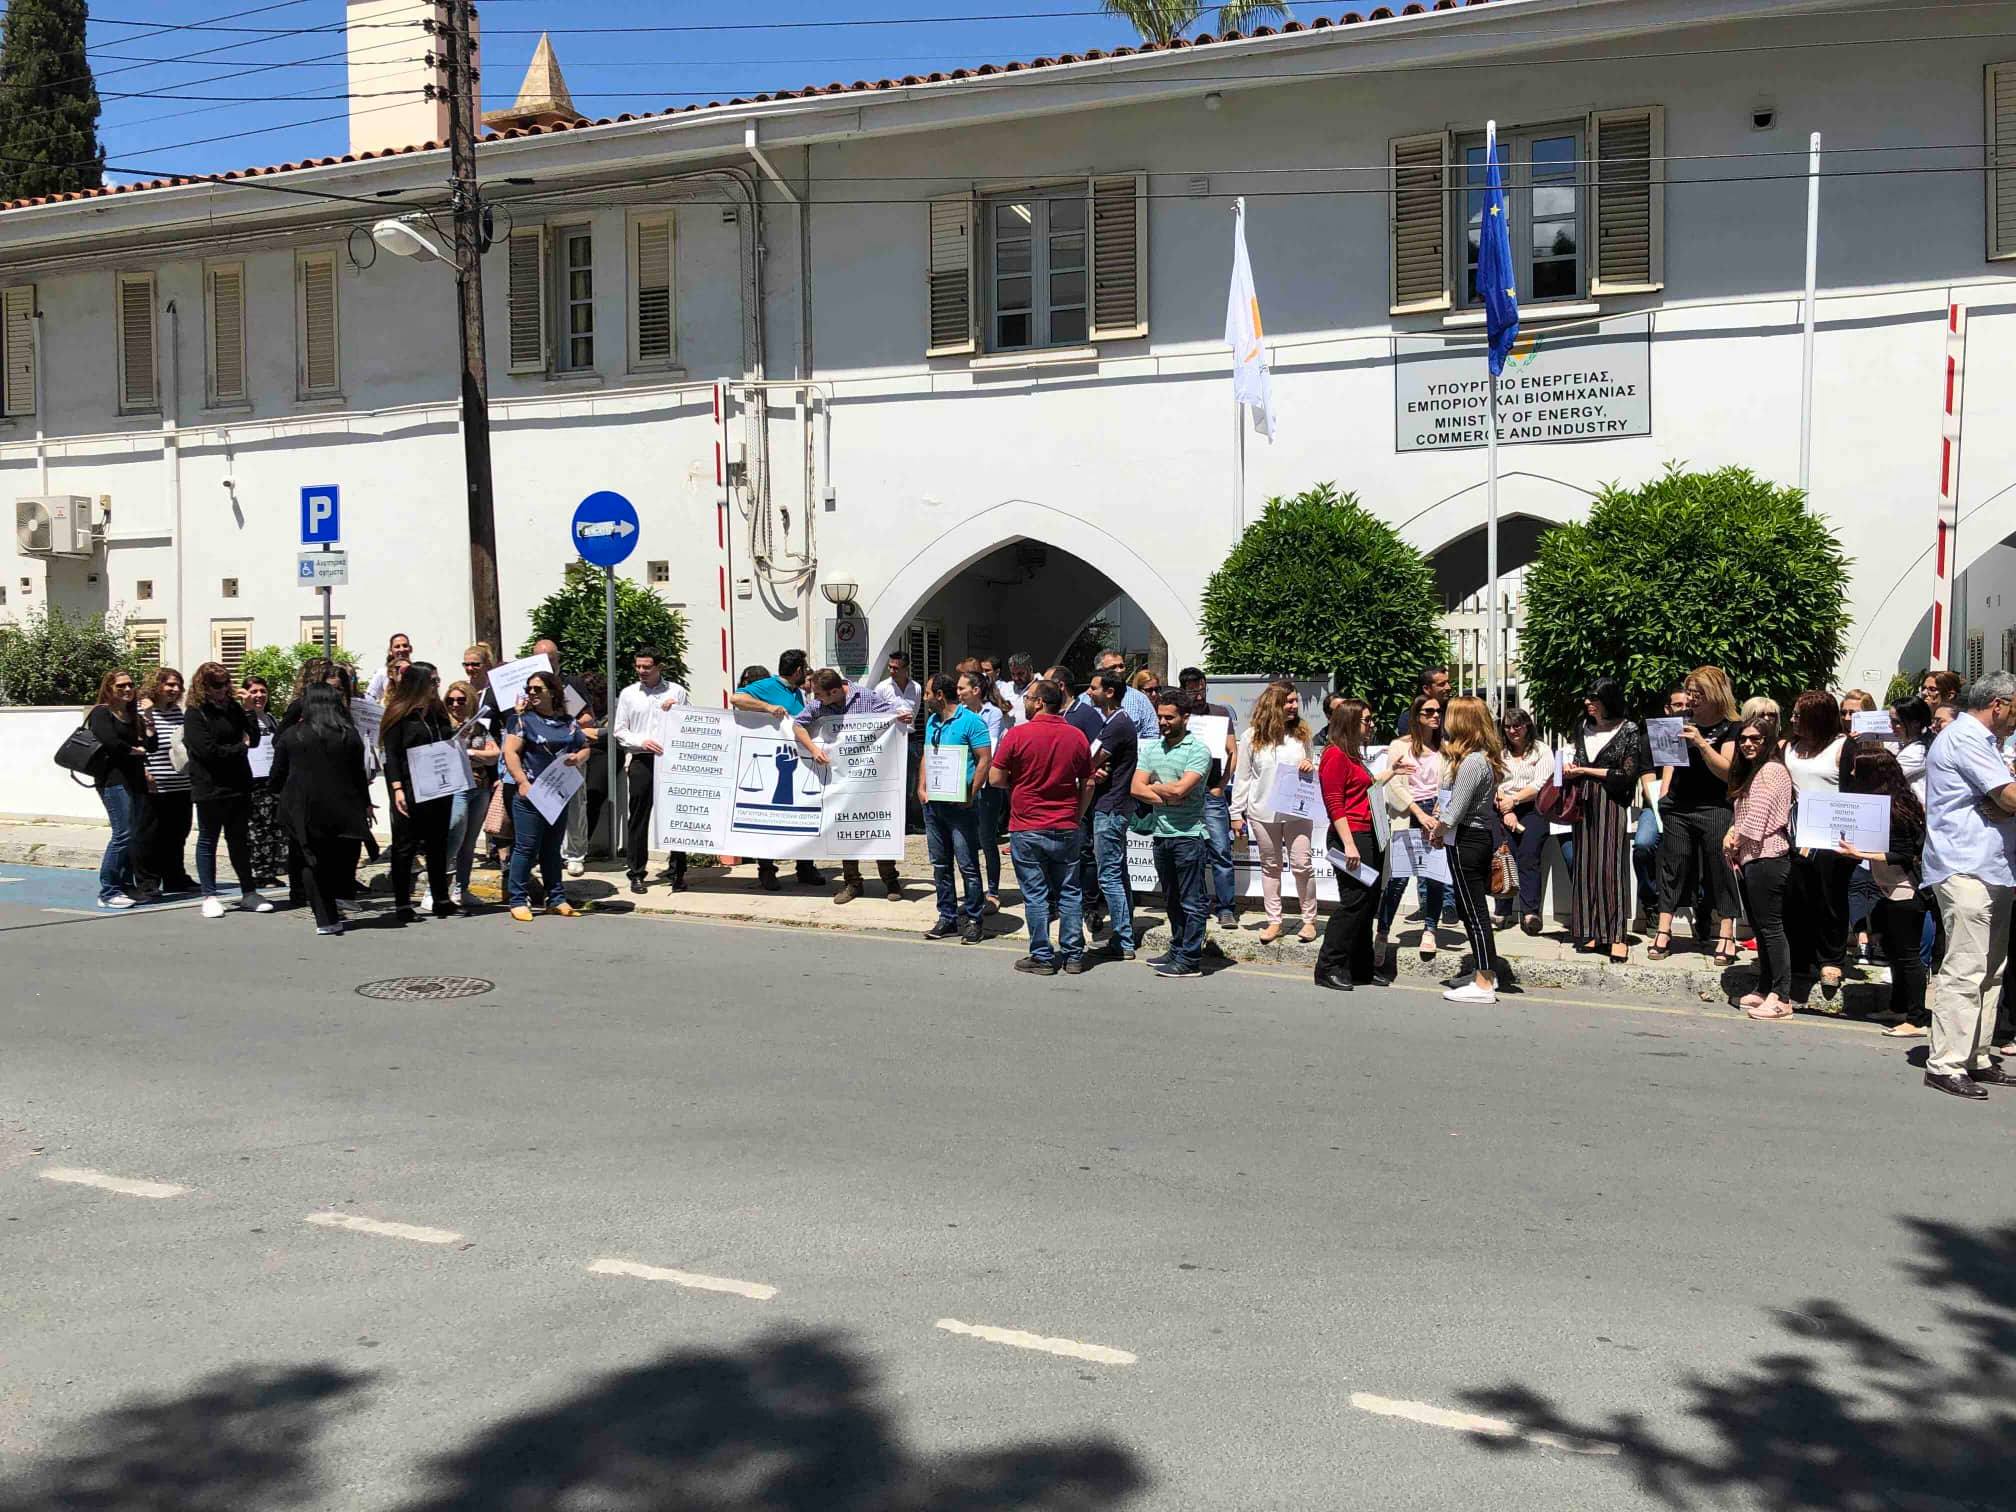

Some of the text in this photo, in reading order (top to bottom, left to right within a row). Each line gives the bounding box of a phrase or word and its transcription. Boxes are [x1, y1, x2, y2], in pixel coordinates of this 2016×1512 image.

[1427, 371, 1614, 396] ΥΠΟΥΡΓΙΟ ΕΝΕΡΓΕΙΑΣ,
[1408, 385, 1637, 413] ΕΜΠΟΡΙΟΥ ΚΑΙ ΒΙΟΜΗΧΑΝΙΑΣ
[1434, 405, 1607, 429] MINISTY OF ENERGY,
[1509, 426, 1542, 440] AND
[1547, 419, 1628, 436] INDUSTRY
[309, 495, 332, 534] P
[684, 714, 720, 724] ΑΡΣΗ ΤΩΝ
[832, 721, 890, 732] ΣΥΜΜΟΡΦΩΣΗ
[859, 733, 877, 743] ΤΗΝ
[701, 743, 722, 751] ΟΡΩΝ
[679, 752, 719, 762] ΣΥΝΘΗΚΩΝ
[668, 786, 721, 798] ΑΞΙΟΠΡΕΠΕΙΑ
[676, 804, 709, 814] ΙΣΟΤΗΤΑ
[835, 810, 892, 821] ΙΣΗ ΑΜΟΙΒΗ
[670, 820, 712, 831] ΕΡΓΑΣΙΑΚΑ
[837, 829, 892, 839] ΙΣΗ ΕΡΓΑΣΙΑ
[664, 836, 714, 848] ΔΙΚΑΙΩΜΑΤΑ
[1127, 839, 1154, 848] ΟΤΗΤΑ
[1311, 848, 1323, 856] ΣΗ
[1128, 856, 1153, 865] ΑΣΙΑΚ
